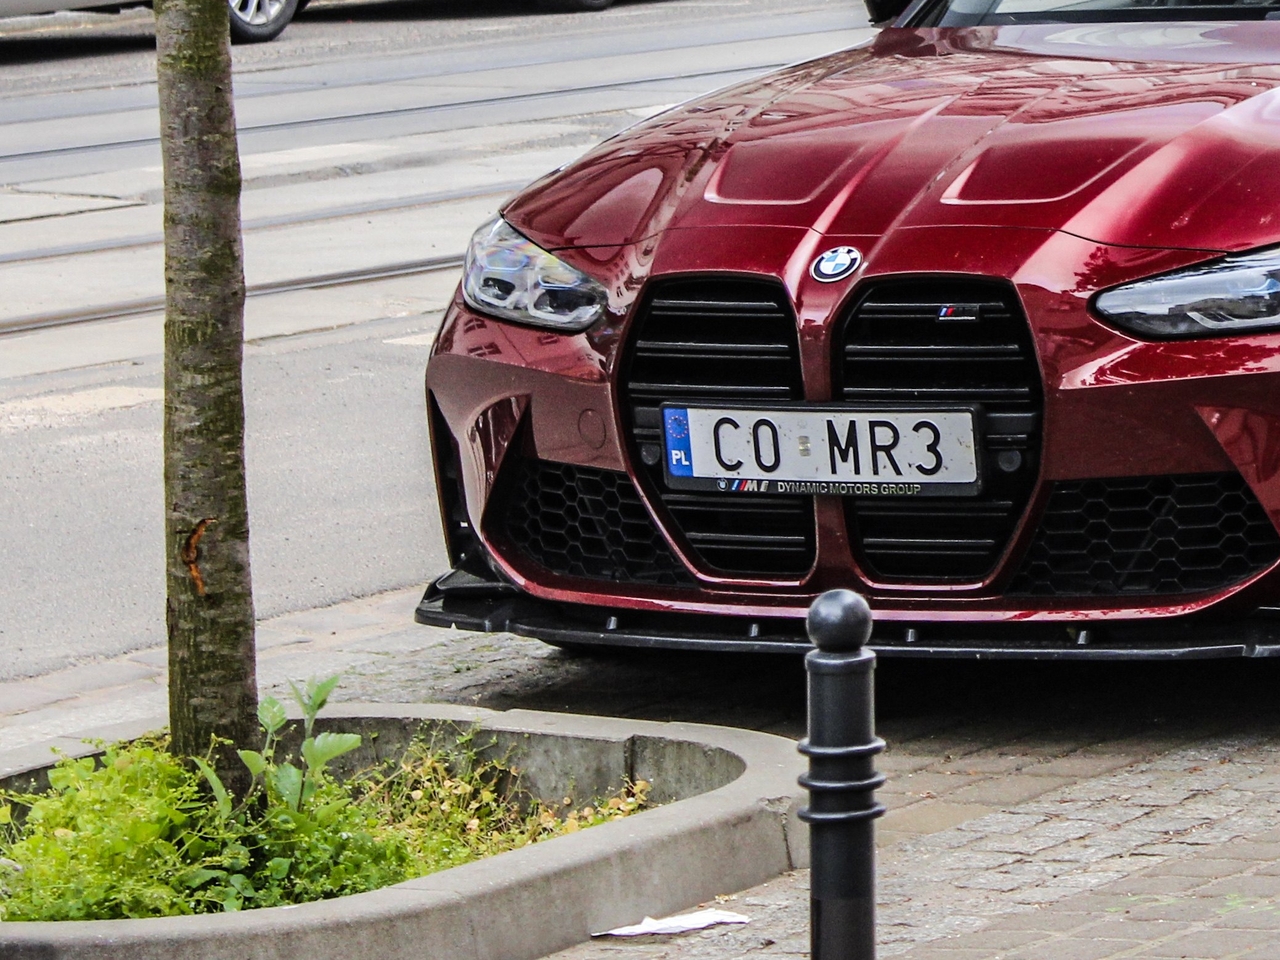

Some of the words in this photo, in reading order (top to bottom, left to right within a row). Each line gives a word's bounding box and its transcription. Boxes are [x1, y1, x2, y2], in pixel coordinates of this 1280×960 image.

[826, 419, 944, 476] MR3
[671, 450, 690, 466] PL
[777, 481, 828, 494] DYNAMIC
[829, 483, 879, 495] MOTORS
[880, 484, 922, 495] GROUP
